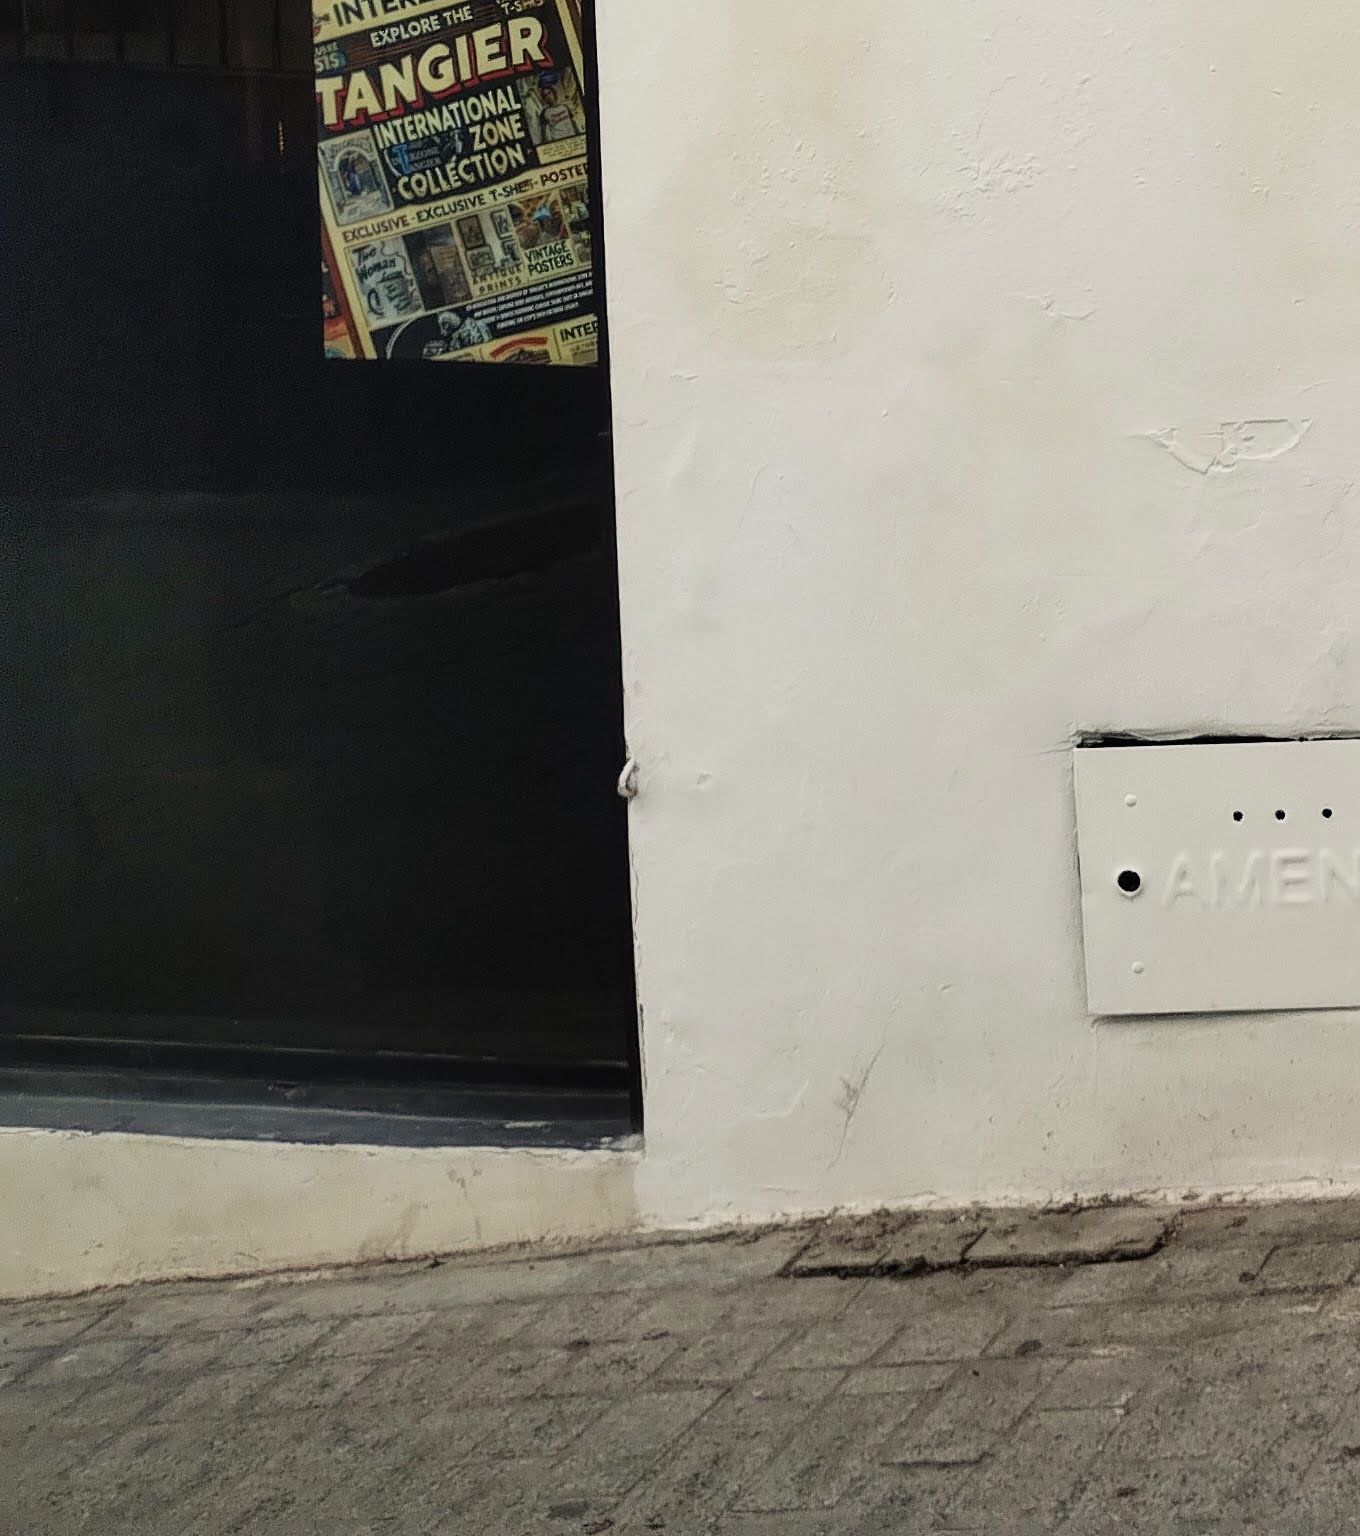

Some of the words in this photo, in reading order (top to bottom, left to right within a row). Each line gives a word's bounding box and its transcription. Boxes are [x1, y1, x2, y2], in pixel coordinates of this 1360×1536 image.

[370, 12, 440, 48] EXPLORE
[441, 5, 474, 27] THE
[315, 16, 548, 128] TANGIER
[373, 84, 522, 149] INTERNATIONAL
[469, 113, 525, 151] ZONE
[397, 144, 526, 201] COLLECTION
[342, 214, 410, 243] EXCLUSIVE
[416, 194, 487, 223] EXCLUSIVE
[525, 239, 570, 263] VINTAGE
[527, 253, 574, 277] POSTERS
[479, 276, 522, 295] PRINTS
